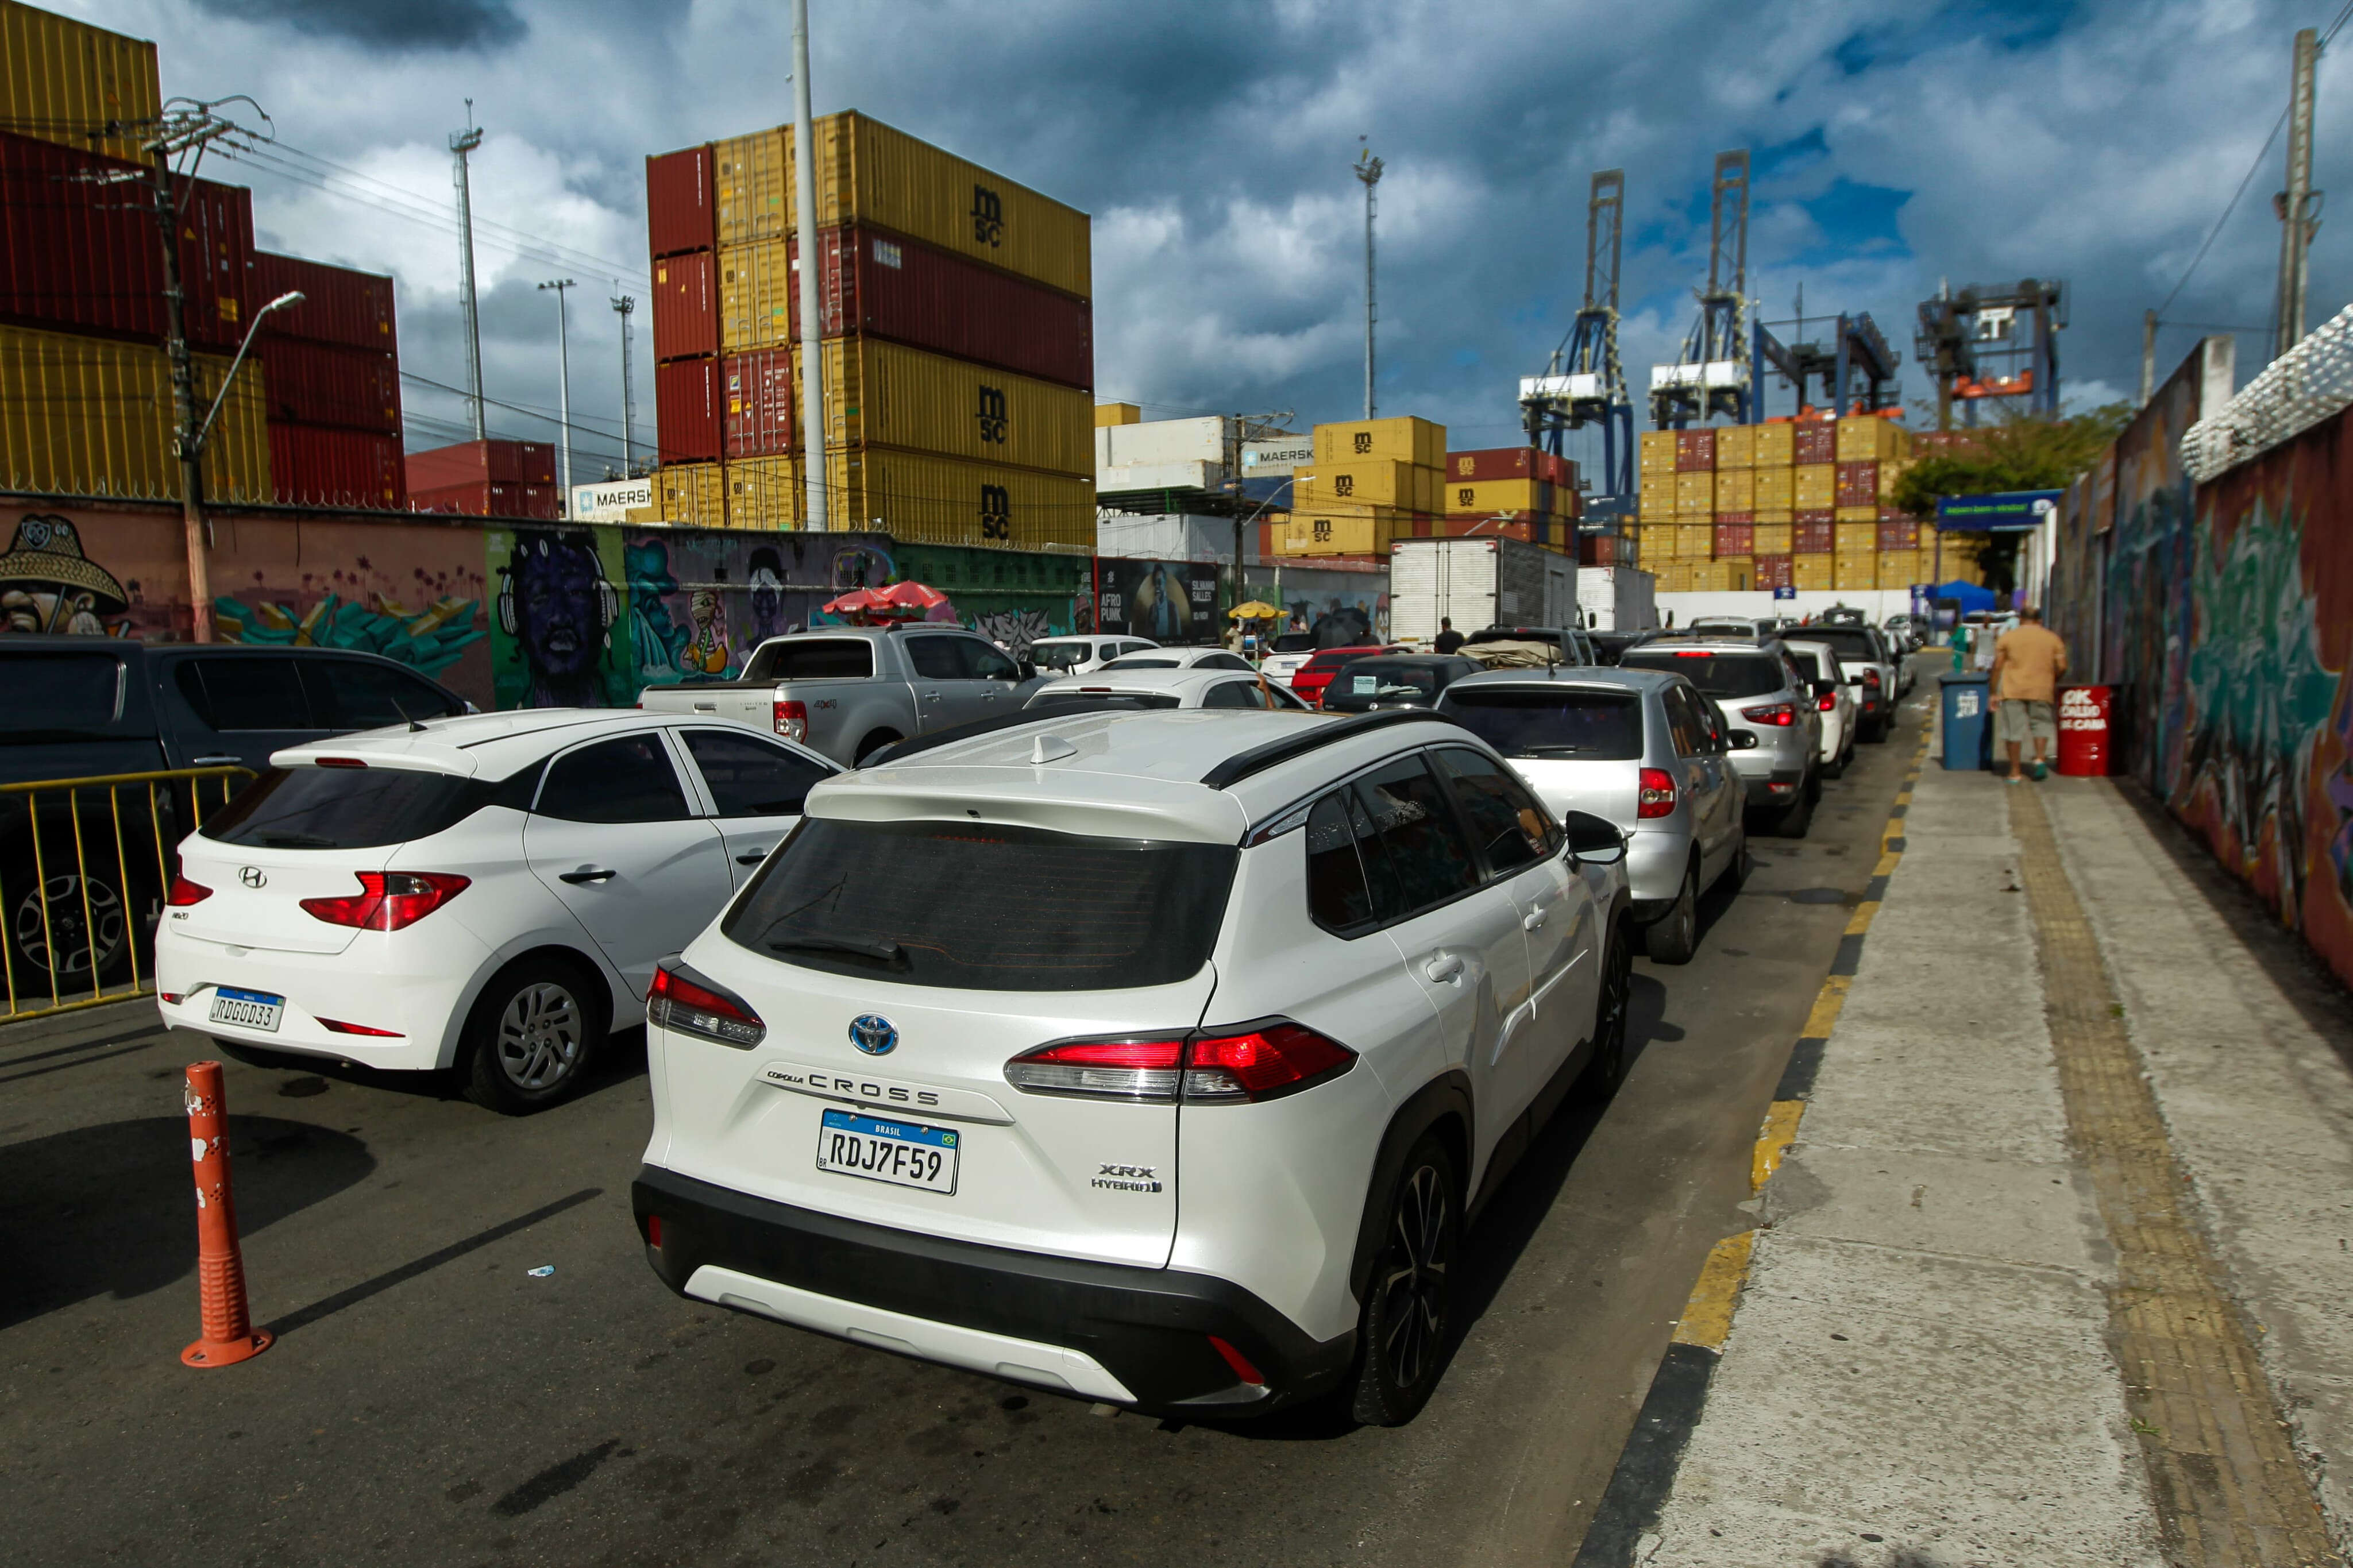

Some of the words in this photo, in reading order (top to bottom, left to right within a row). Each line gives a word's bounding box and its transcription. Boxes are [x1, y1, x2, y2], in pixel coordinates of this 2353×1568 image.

[1260, 449, 1314, 462] MAERSK
[1101, 593, 1121, 607] AFRO
[1101, 608, 1121, 621] PUNK
[2062, 689, 2094, 705] OK
[2059, 704, 2101, 719] CALDO
[2072, 718, 2107, 732] CANA
[767, 1070, 804, 1084] COROLLA
[809, 1073, 939, 1106] CROSS
[874, 1124, 901, 1137] BRASIL
[819, 1157, 827, 1168] BR
[830, 1133, 942, 1181] RDJ7F59
[1098, 1161, 1156, 1179] XRX
[1091, 1176, 1151, 1192] HYBRID
